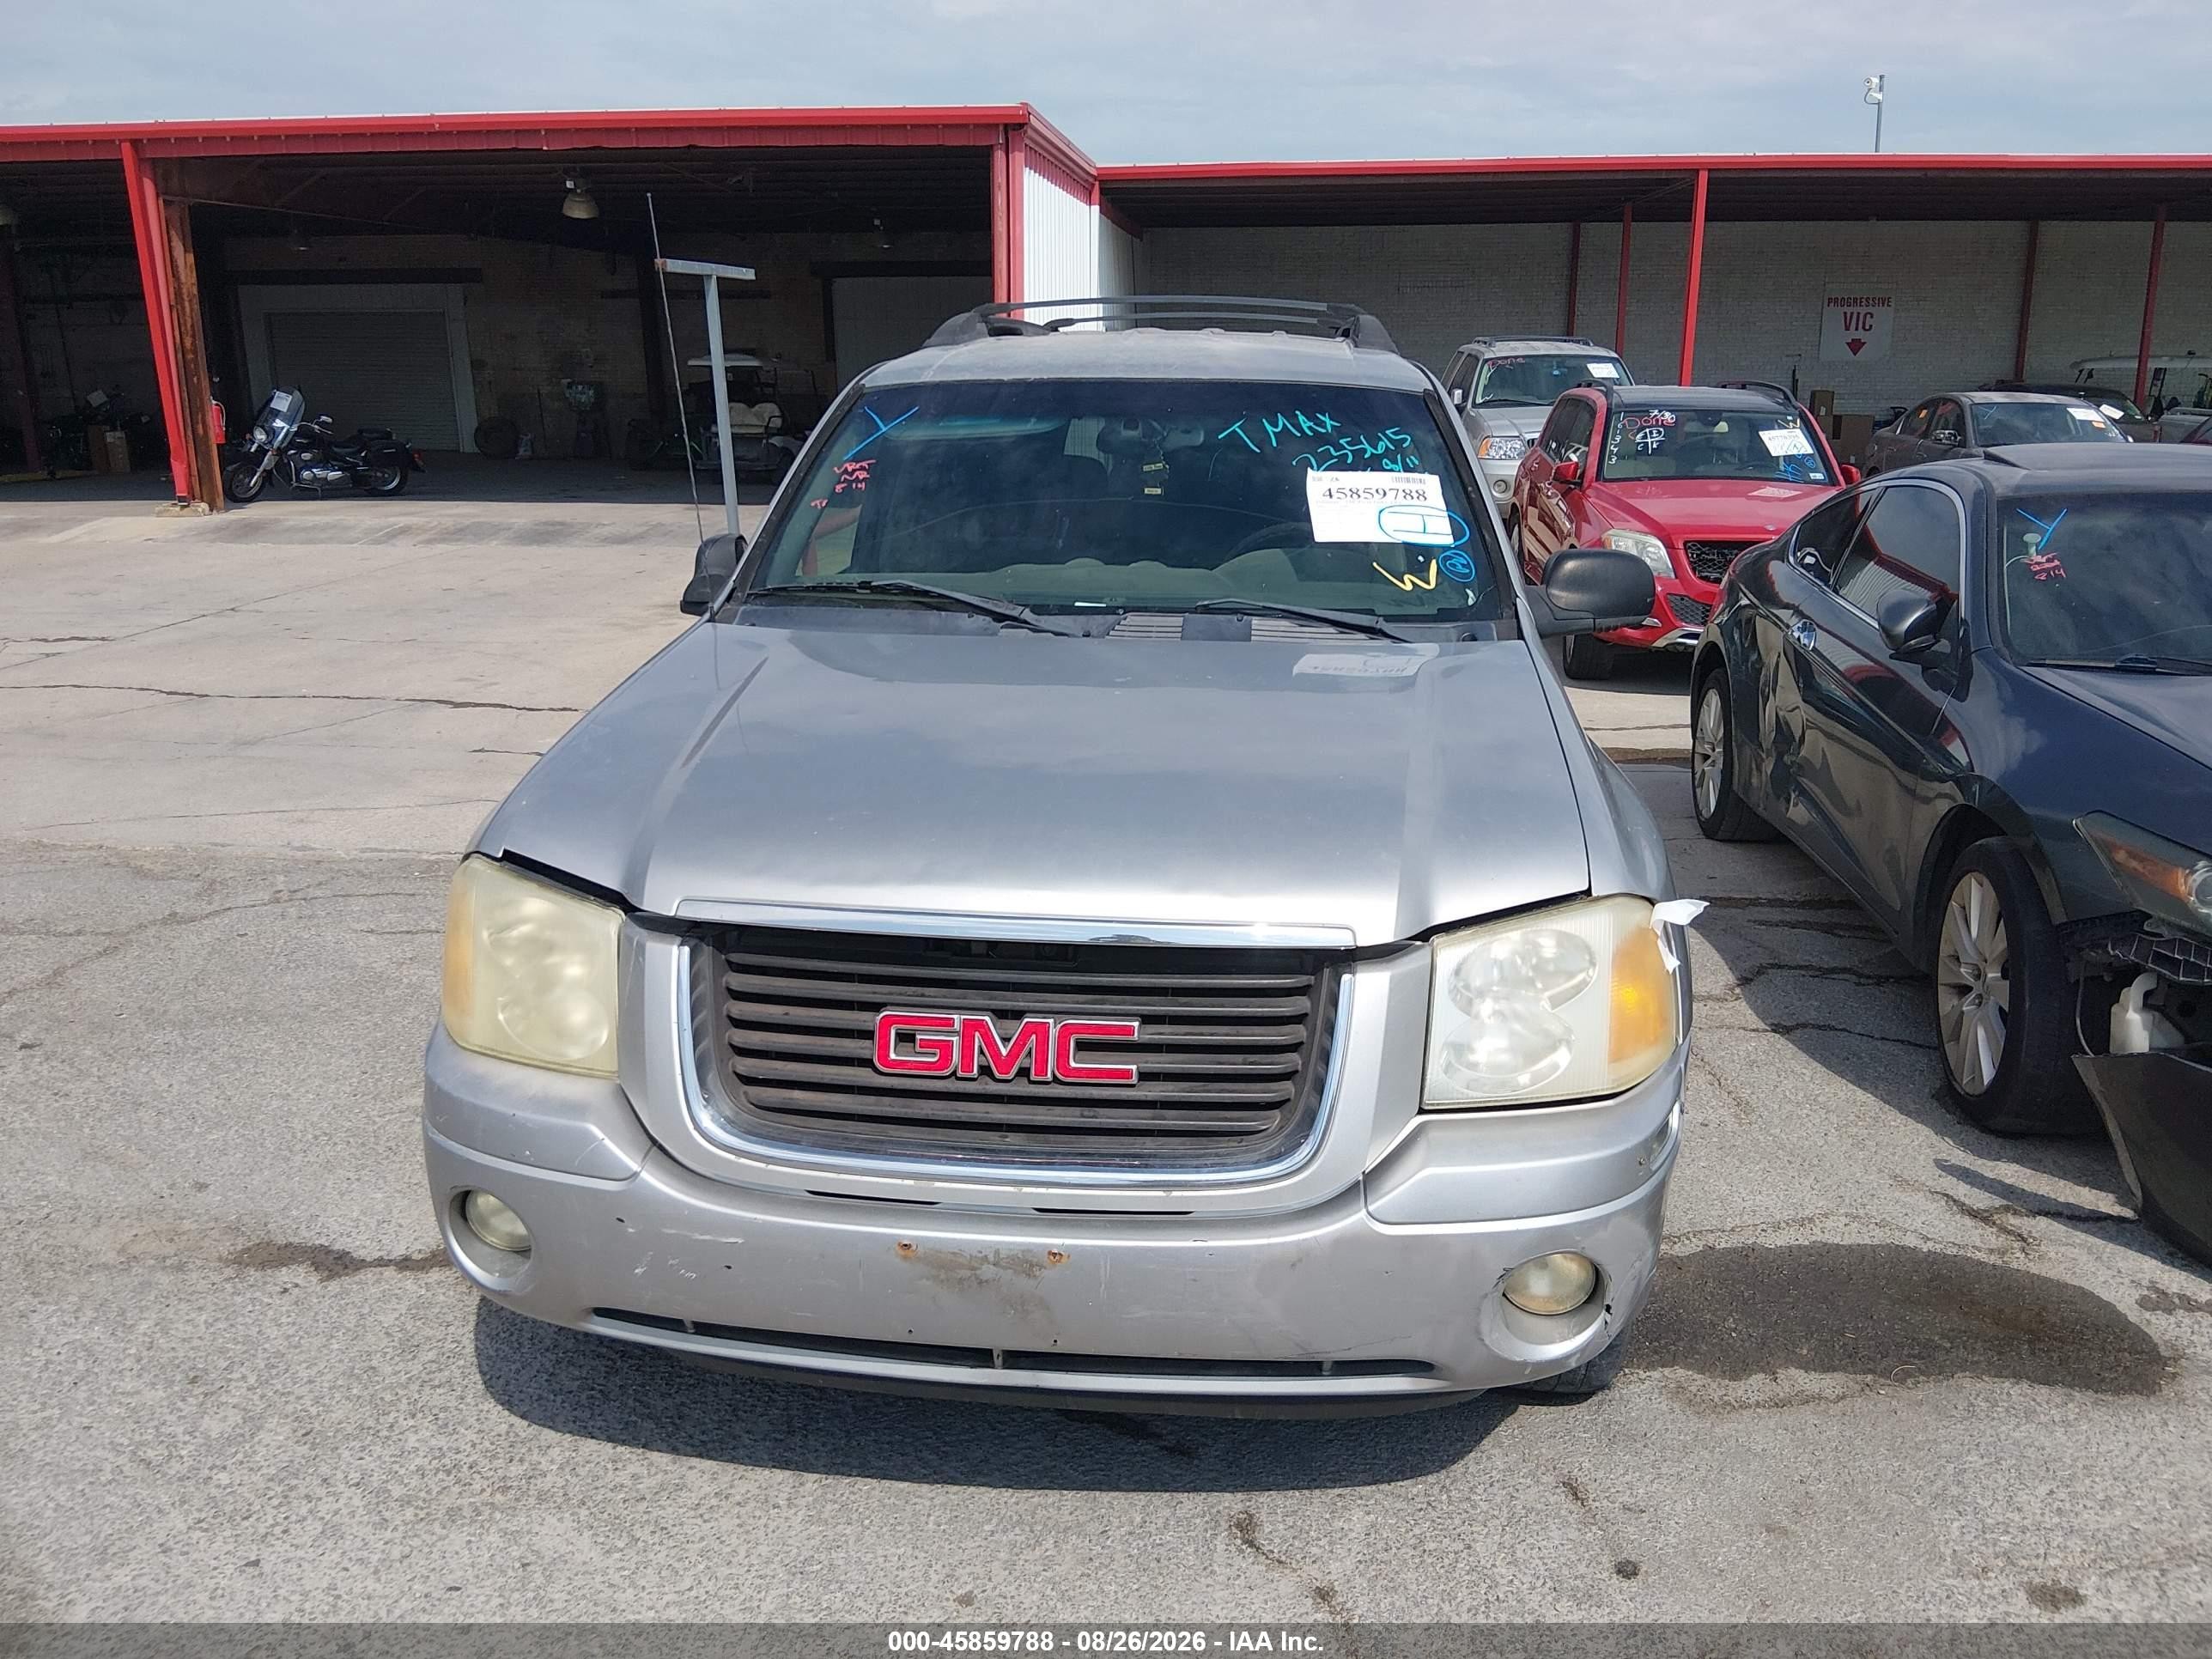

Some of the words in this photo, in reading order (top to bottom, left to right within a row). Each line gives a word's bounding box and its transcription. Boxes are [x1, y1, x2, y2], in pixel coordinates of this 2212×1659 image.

[1826, 296, 1893, 308] PROGRESSIVE
[1843, 311, 1875, 332] VIC
[1322, 487, 1428, 502] 45859788
[874, 1007, 1143, 1085] GMC
